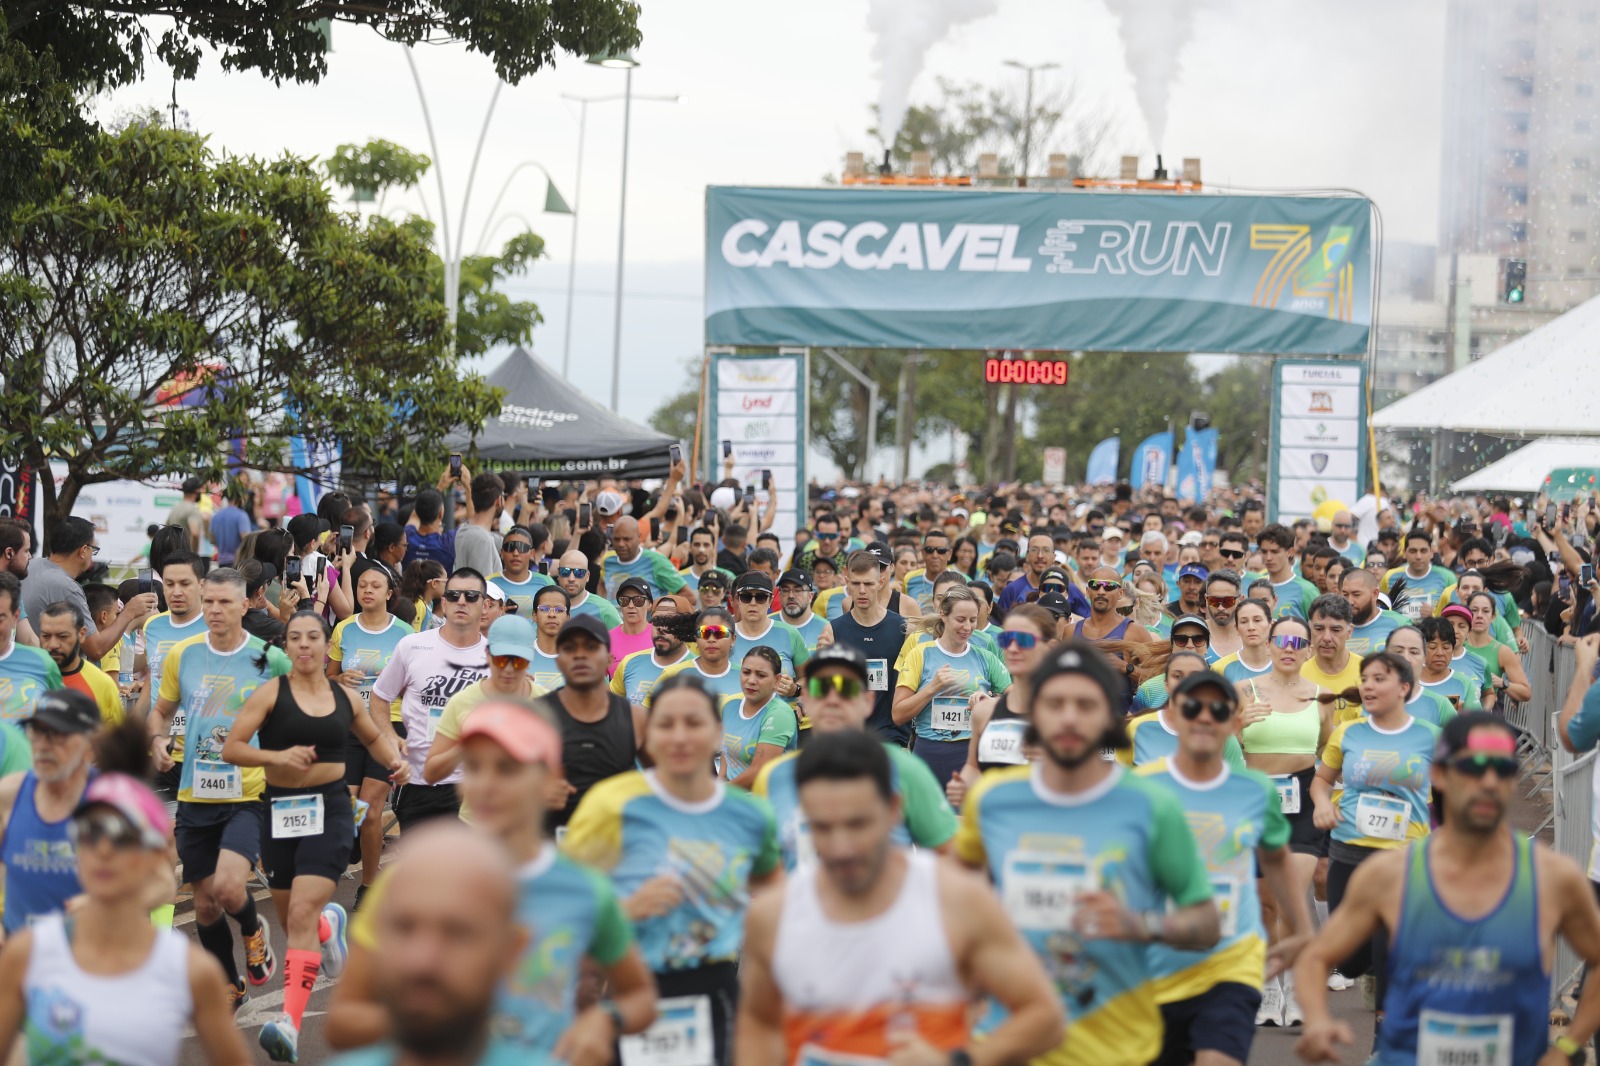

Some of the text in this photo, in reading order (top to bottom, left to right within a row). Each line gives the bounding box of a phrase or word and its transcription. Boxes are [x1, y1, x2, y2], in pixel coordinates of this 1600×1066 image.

[721, 219, 1232, 276] CASCAVEL RUN
[478, 457, 628, 473] rigocirilo.com.br
[941, 711, 962, 722] 1421
[990, 738, 1016, 751] 1307
[200, 778, 226, 790] 2440
[283, 815, 307, 828] 2152
[1368, 814, 1389, 828] 277
